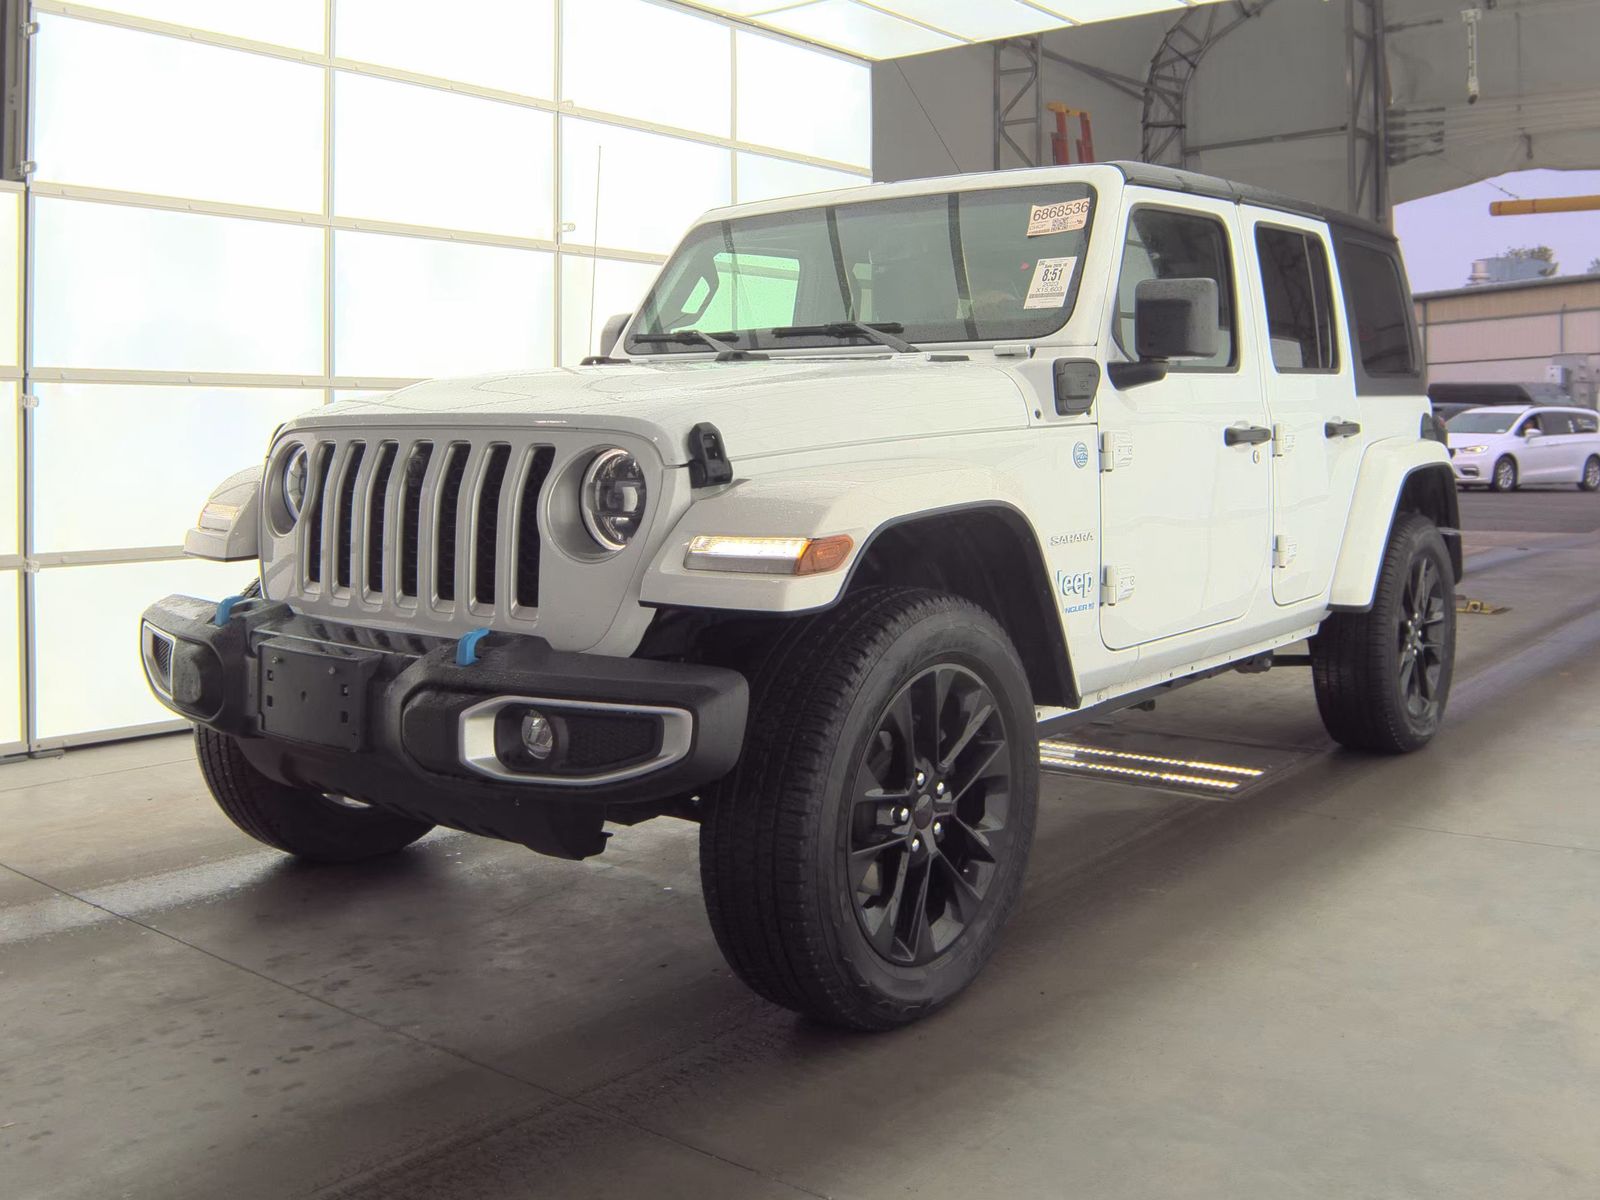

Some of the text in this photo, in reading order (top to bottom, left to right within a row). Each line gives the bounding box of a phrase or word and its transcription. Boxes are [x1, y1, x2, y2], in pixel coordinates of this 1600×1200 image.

[1033, 201, 1089, 221] 6868536
[1042, 268, 1063, 282] 8:51
[1050, 533, 1093, 546] SAHARA
[1057, 570, 1092, 598] Jeep
[1065, 604, 1088, 614] NGLER
